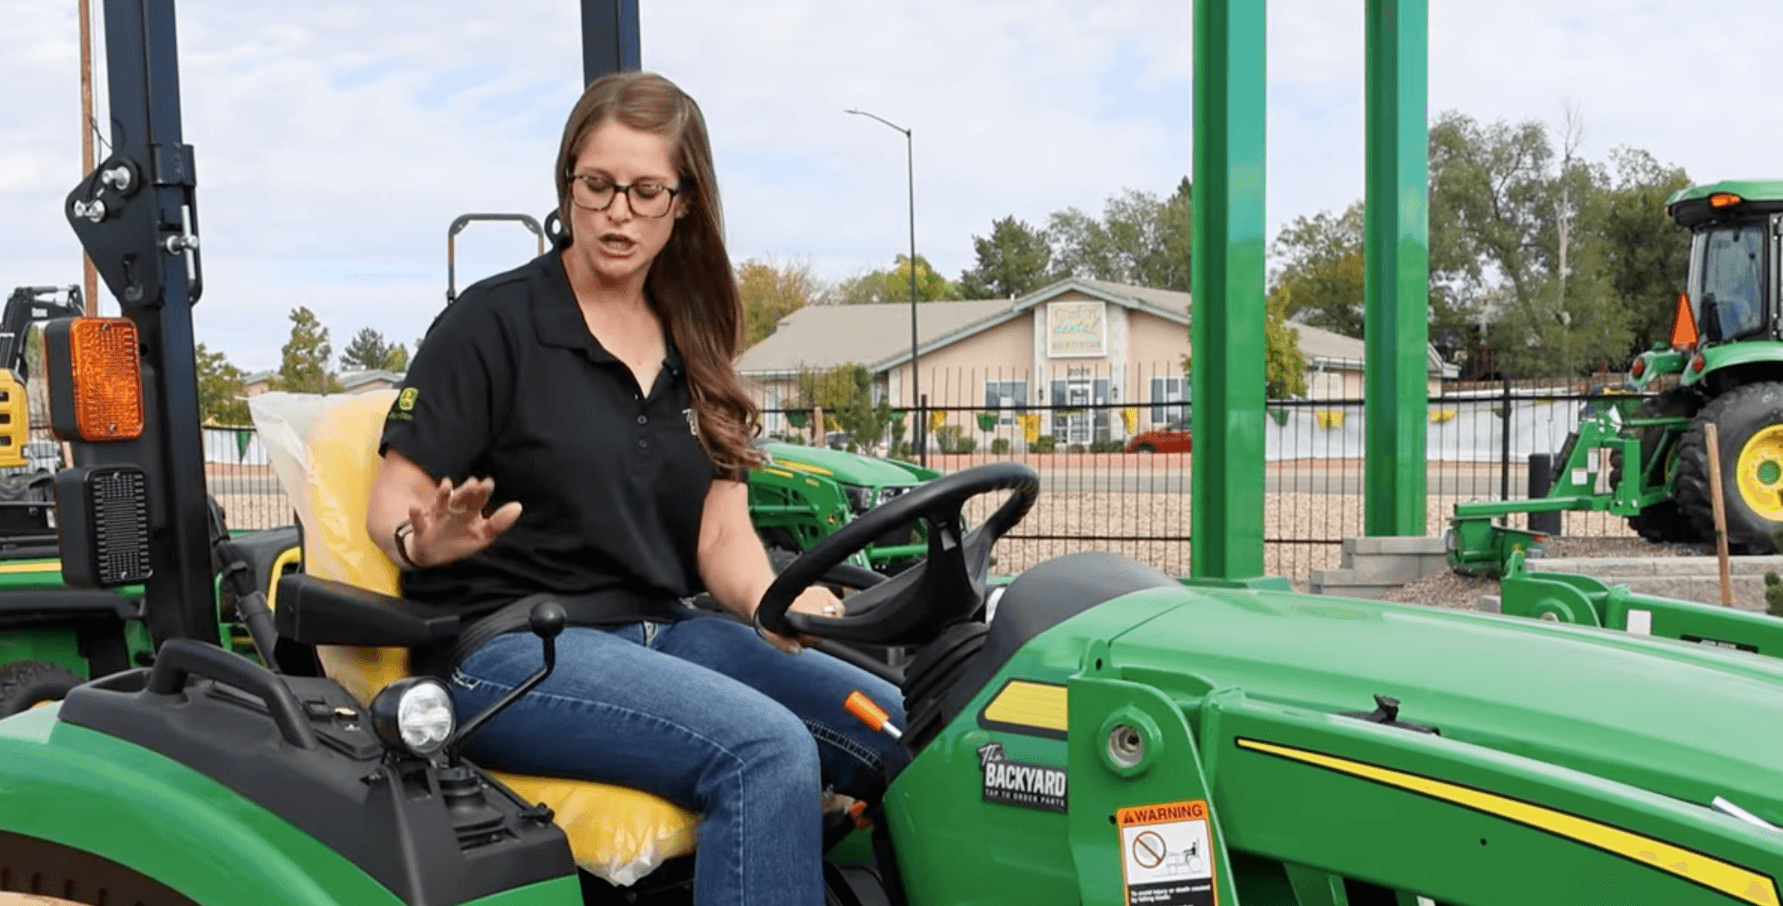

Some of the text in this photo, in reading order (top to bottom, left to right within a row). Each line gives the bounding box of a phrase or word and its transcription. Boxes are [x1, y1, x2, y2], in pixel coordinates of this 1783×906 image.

[979, 744, 1003, 766] The
[985, 763, 1066, 797] BACKYARD
[985, 788, 1065, 807] TAP TO ORDER PARTS
[1134, 804, 1202, 822] WARNING
